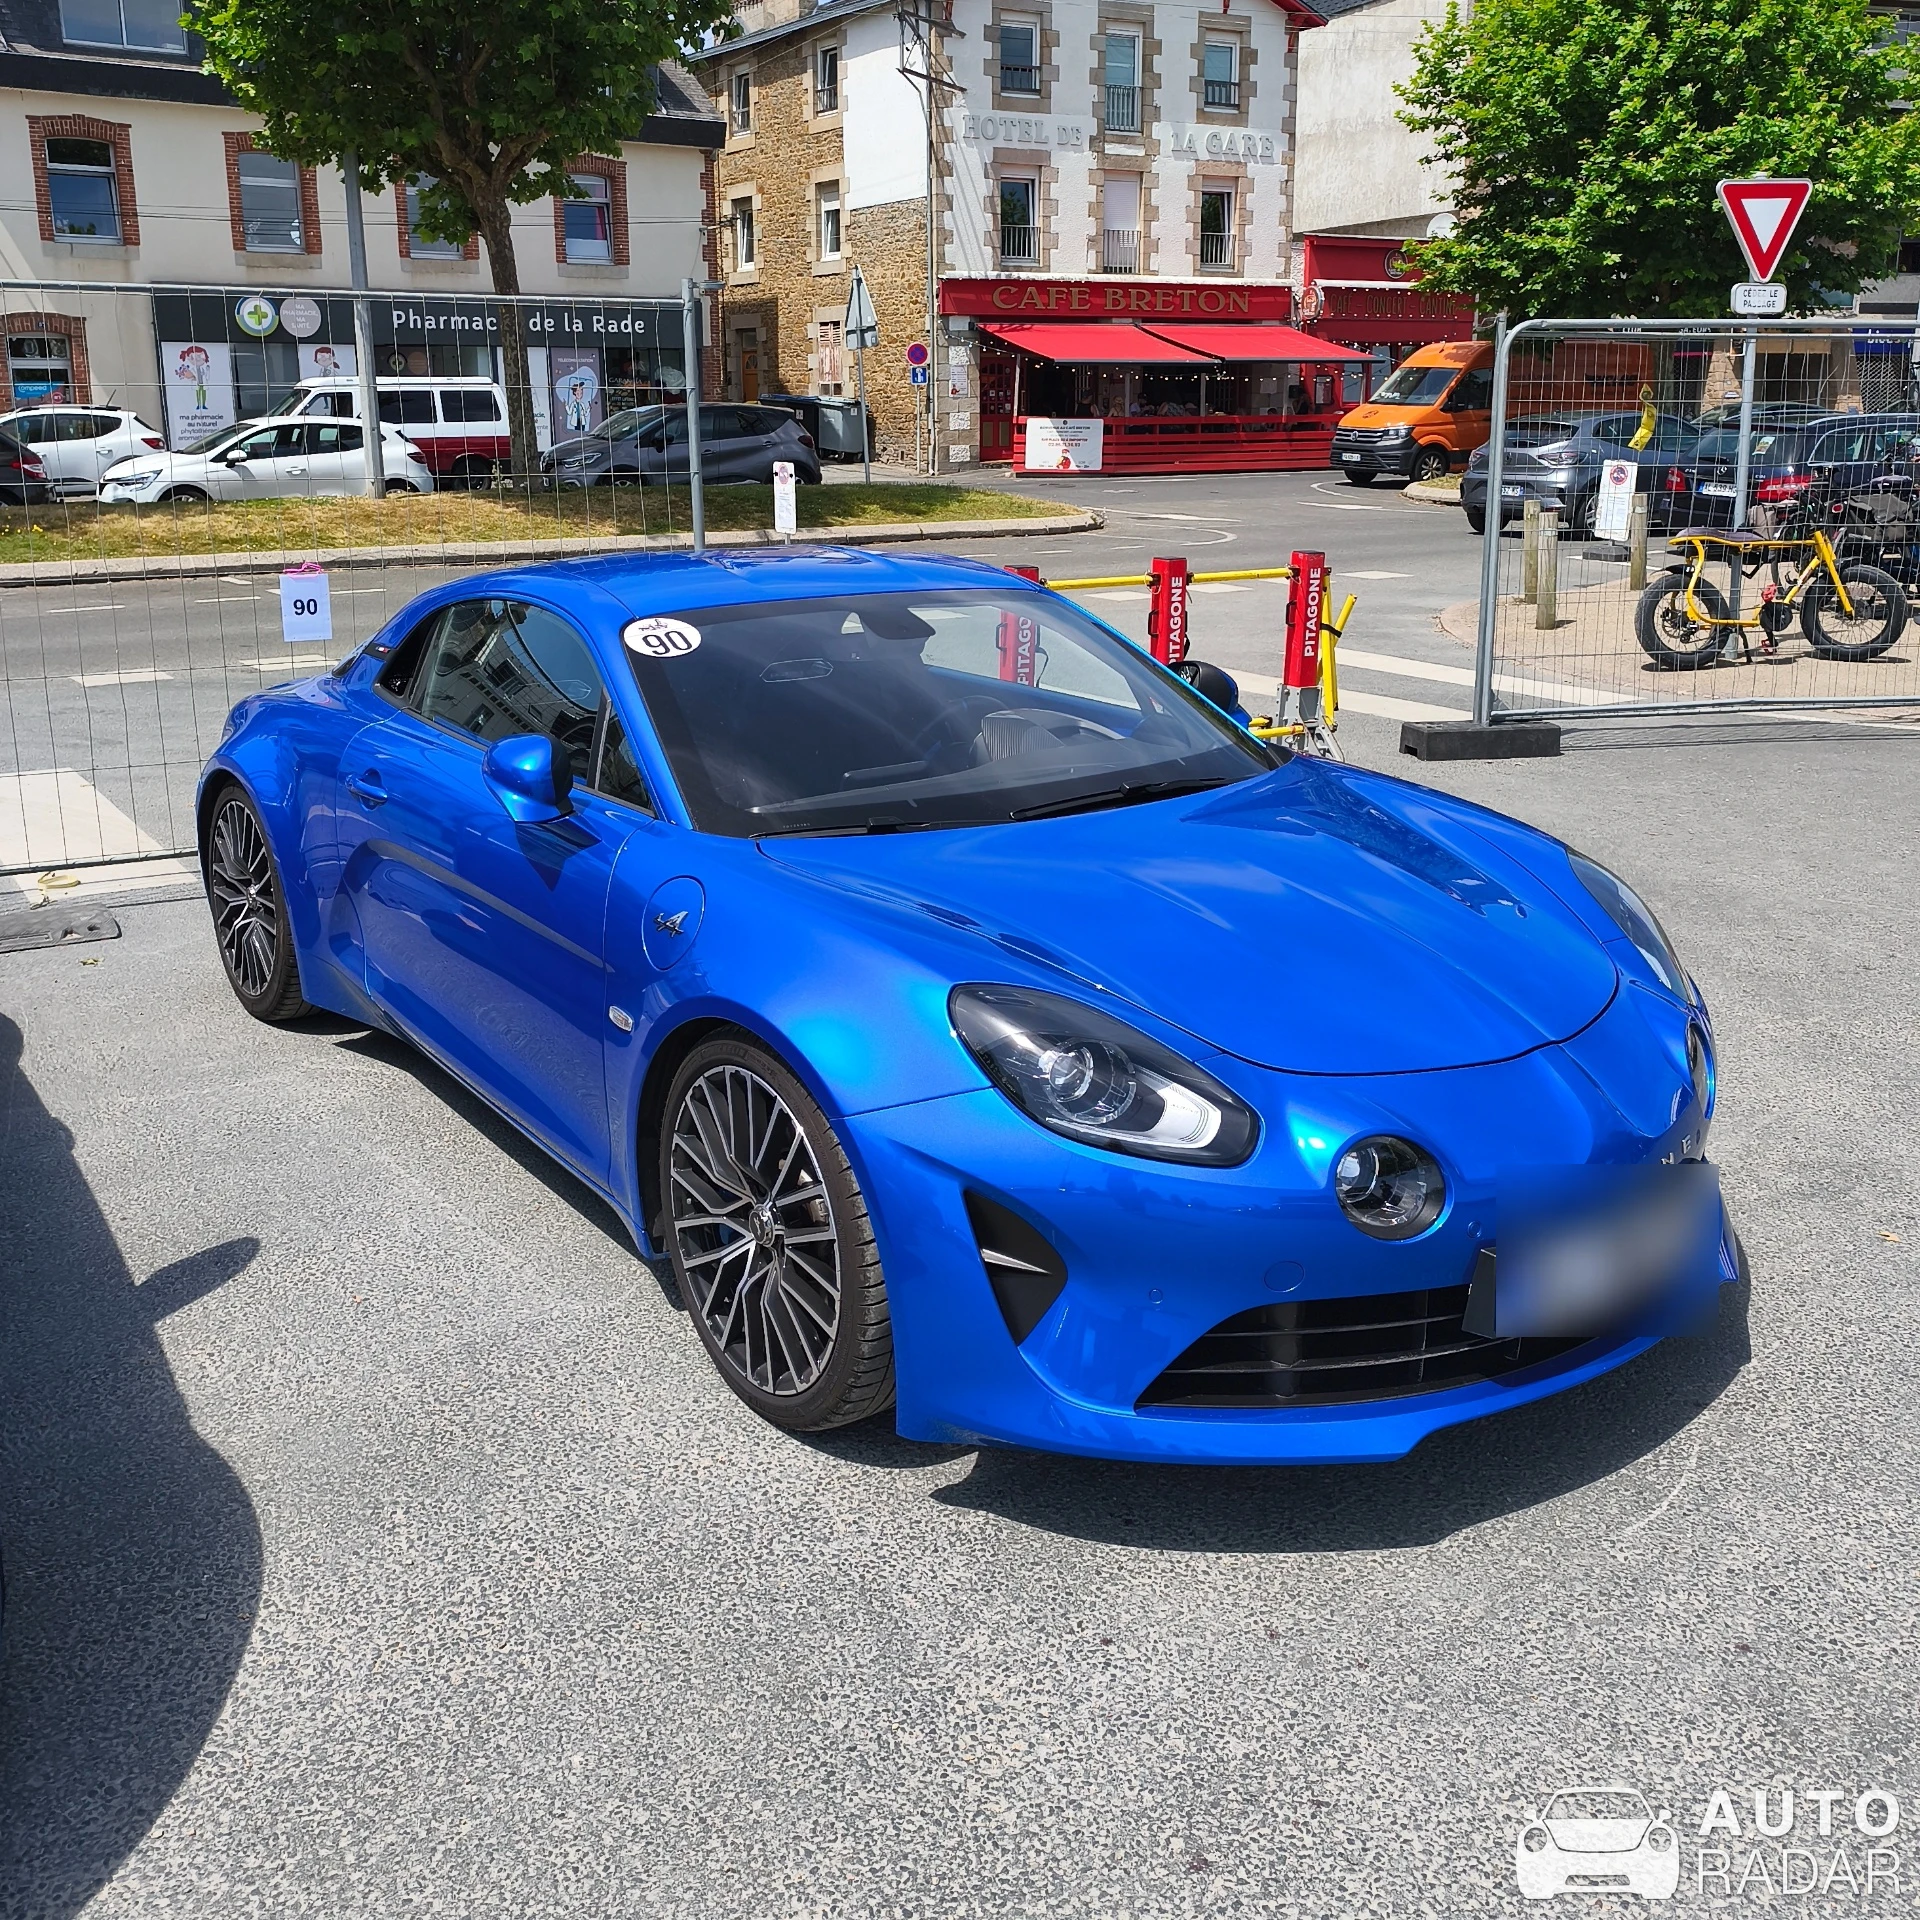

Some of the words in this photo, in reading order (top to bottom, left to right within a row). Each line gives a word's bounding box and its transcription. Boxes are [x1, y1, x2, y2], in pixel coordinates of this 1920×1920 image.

[963, 114, 1050, 143] HOTEL
[1057, 125, 1083, 146] DE
[1171, 131, 1198, 153] LA
[1206, 131, 1275, 157] GARE
[992, 286, 1091, 310] CAFE
[1104, 288, 1250, 313] BRETON
[1770, 289, 1779, 298] LE
[393, 308, 499, 332] Pharmac
[528, 311, 555, 332] de
[564, 312, 584, 333] la
[592, 313, 646, 334] Rade
[293, 598, 318, 615] 90
[1304, 567, 1321, 657] PITAGONE
[642, 630, 693, 655] 90
[1017, 616, 1032, 686] PITAGO
